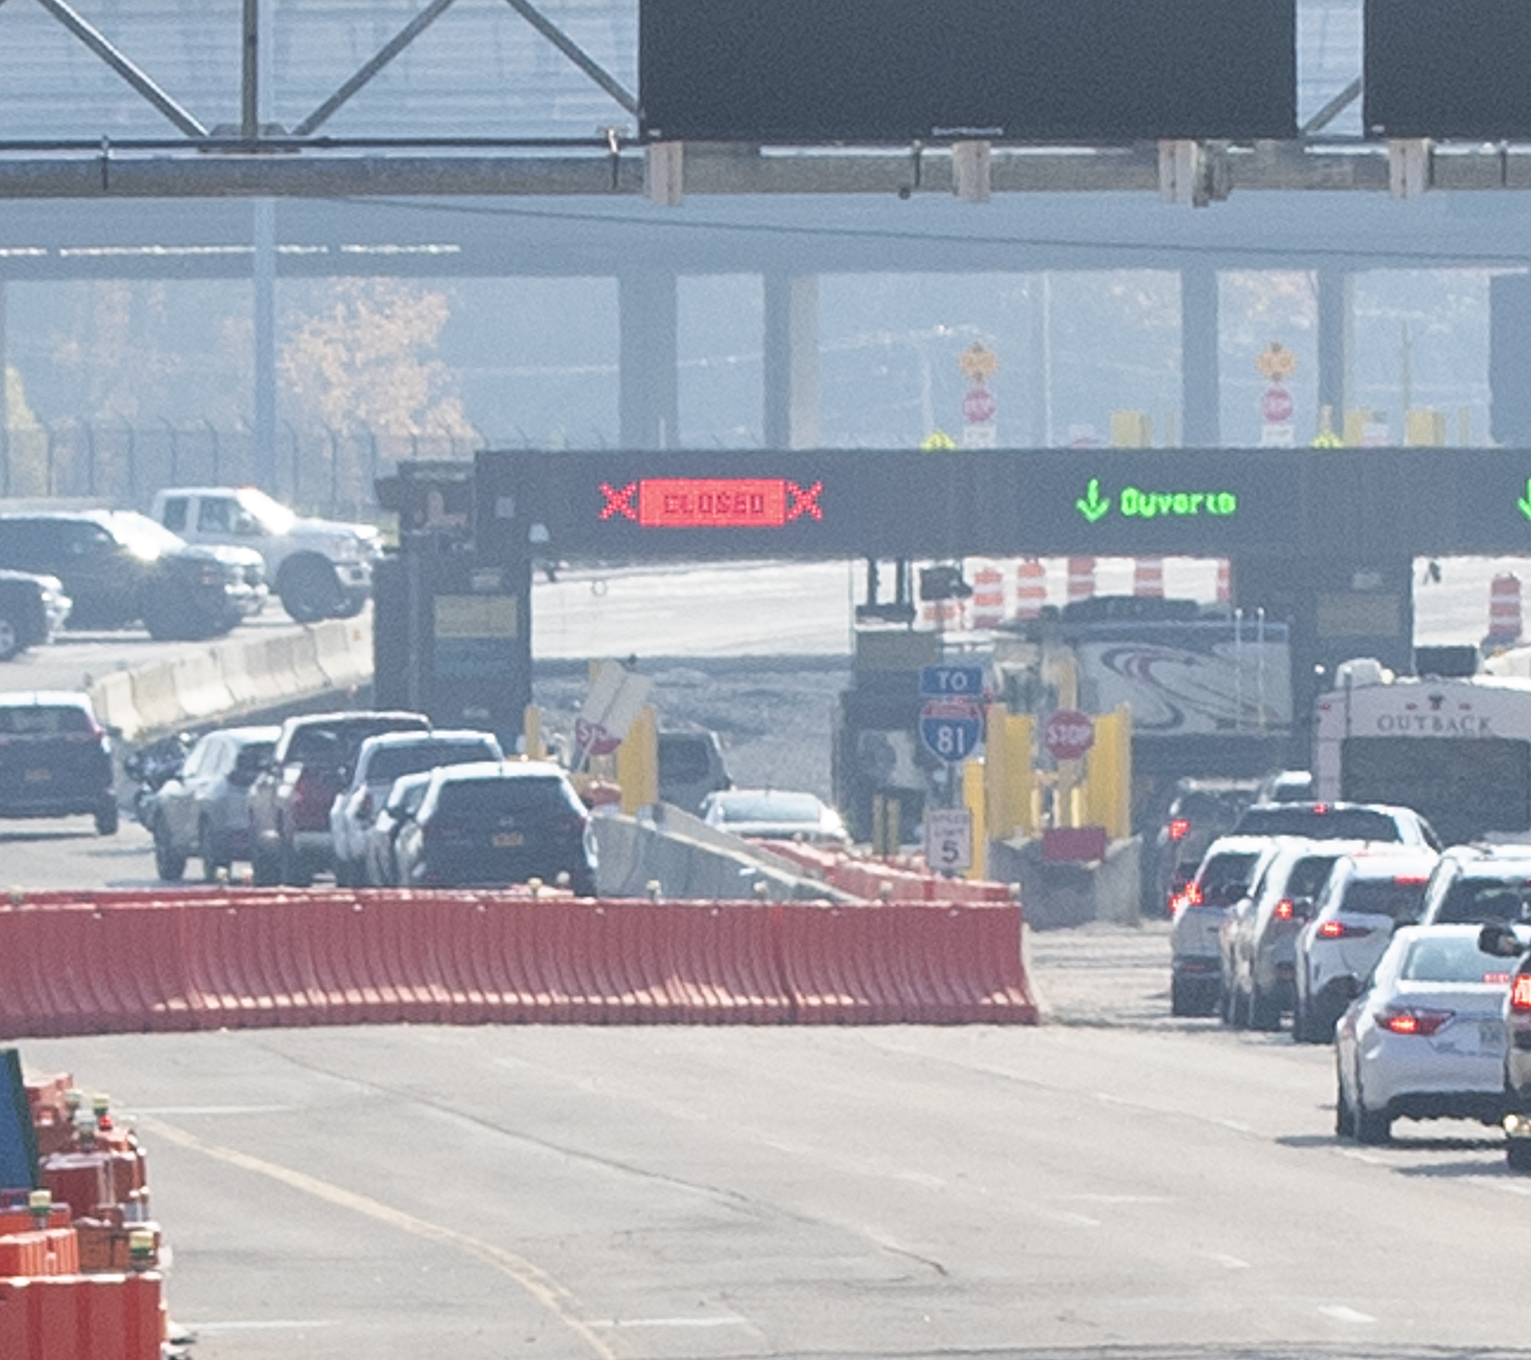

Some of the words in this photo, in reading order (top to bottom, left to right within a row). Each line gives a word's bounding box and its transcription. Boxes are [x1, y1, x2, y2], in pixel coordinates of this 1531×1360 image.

[664, 493, 764, 514] CLOSED
[937, 671, 968, 690] TO
[1376, 714, 1492, 732] OUTBACK
[937, 725, 965, 754] 81
[1047, 723, 1093, 746] STOP
[941, 839, 959, 863] 5
